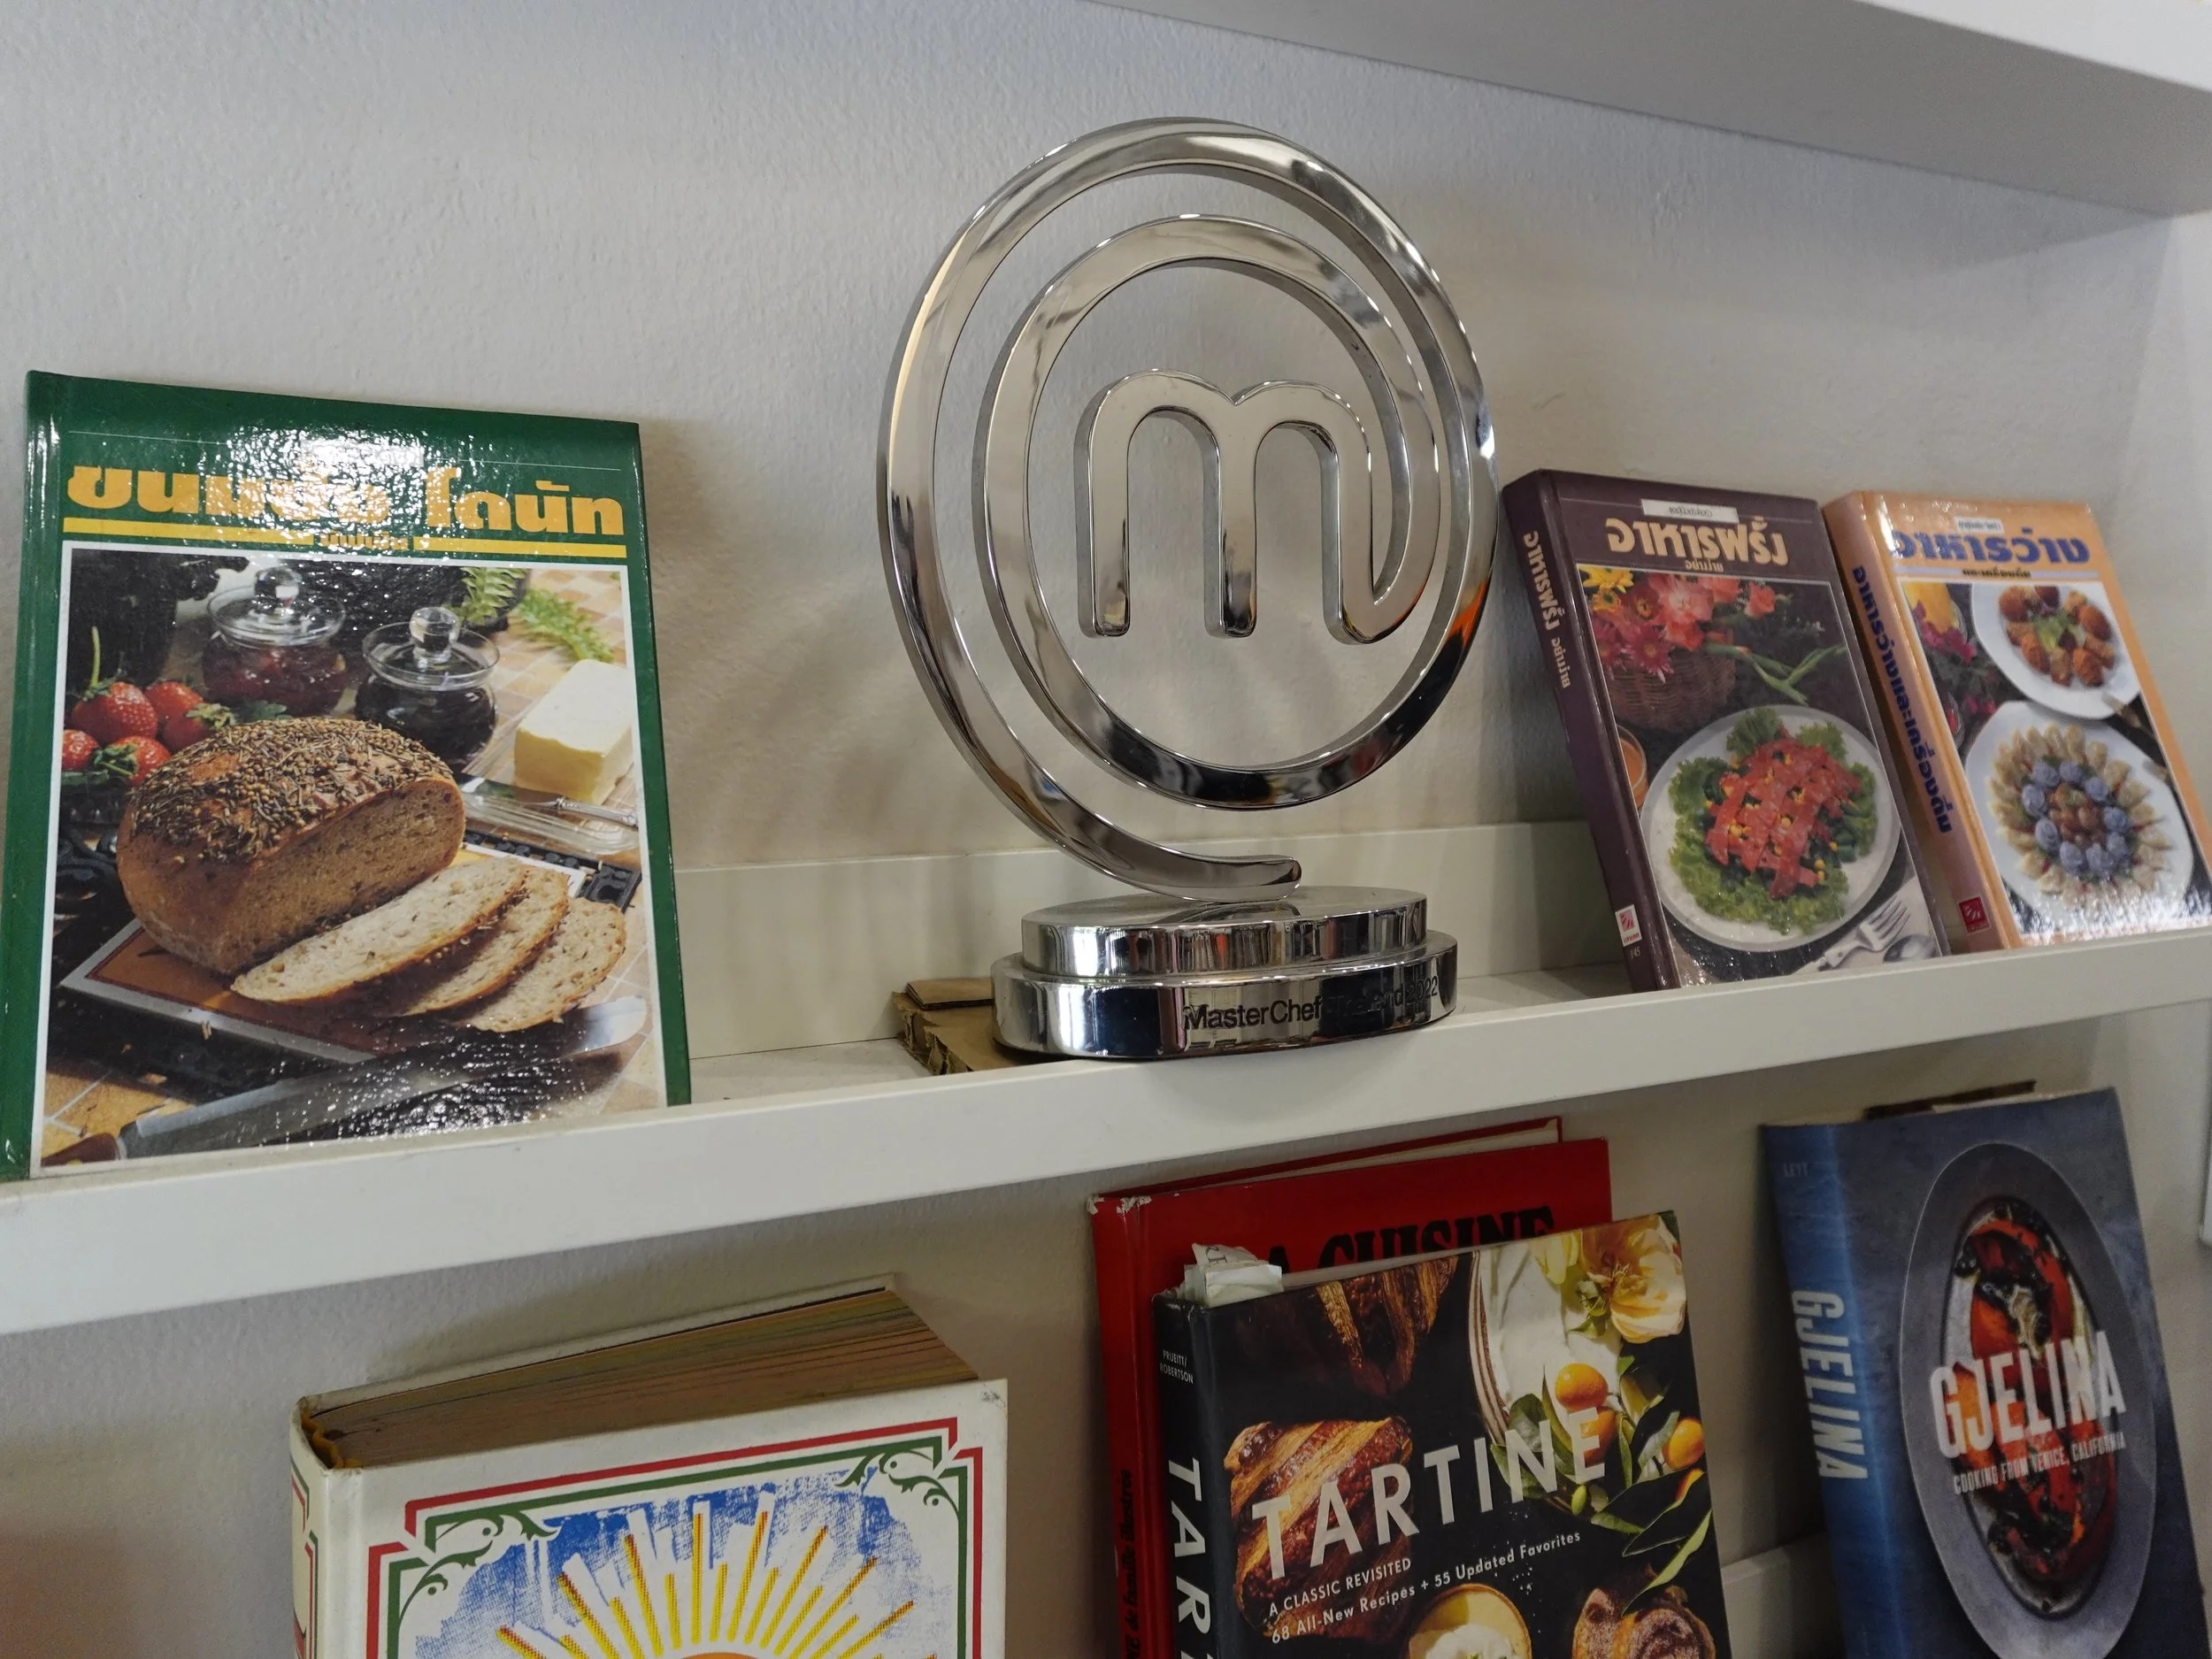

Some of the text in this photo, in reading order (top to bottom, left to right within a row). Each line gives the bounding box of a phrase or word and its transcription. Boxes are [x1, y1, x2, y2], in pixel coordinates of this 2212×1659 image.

[426, 467, 625, 535] โดนัท
[1606, 515, 1789, 566] อาหารฝรั่ง
[1524, 531, 1565, 631] อาหารฝรั่ง
[1891, 526, 2091, 565] อาหารว่าง
[1853, 565, 1953, 833] อาหารว่างและเครื่องดื่ม
[1183, 995, 1323, 1030] MasterChef
[1405, 975, 1439, 1002] 2022
[1159, 1363, 1194, 1385] ROBERTSON
[1791, 1290, 1869, 1479] GJELINA
[1930, 1331, 2127, 1458] GJELINA
[1252, 1407, 1606, 1581] TARTINE
[1954, 1432, 2127, 1494] COOKING FROM VENICE, CALIFORNIA
[1168, 1457, 1214, 1659] TAR
[1269, 1557, 1412, 1617] A CLASSIC REVISITED
[1271, 1624, 1291, 1645] 68
[1297, 1606, 1356, 1635] All-New
[1360, 1585, 1416, 1614] Recipes
[1434, 1571, 1451, 1587] 55
[1455, 1548, 1516, 1580] Updated
[1520, 1531, 1581, 1559] Favorites
